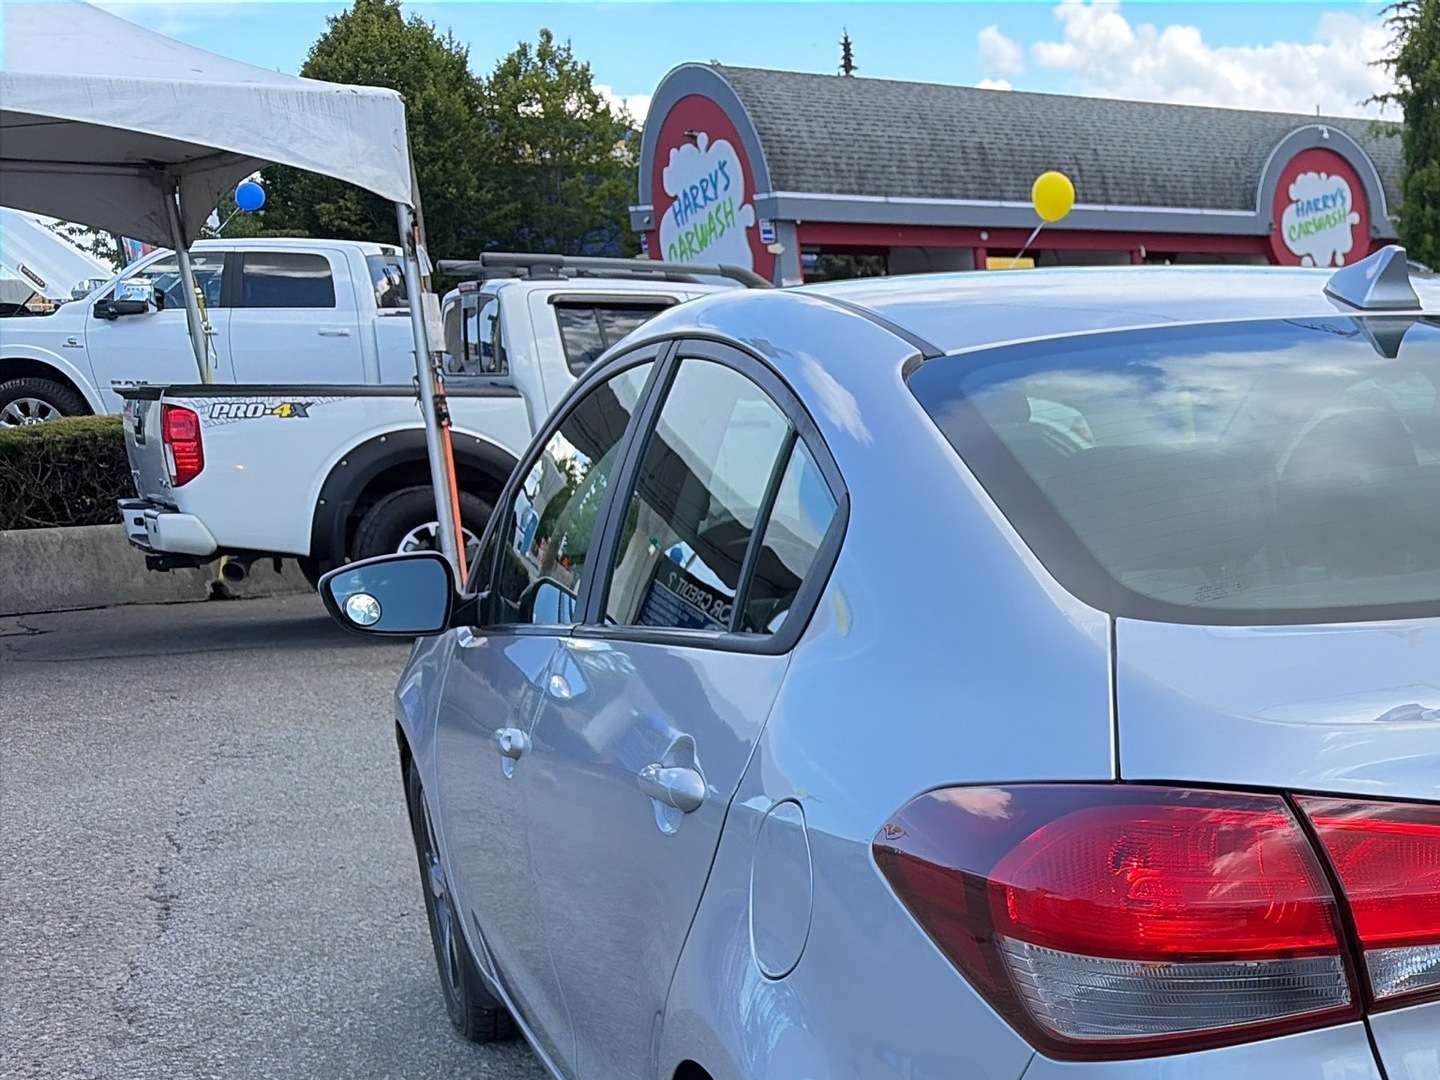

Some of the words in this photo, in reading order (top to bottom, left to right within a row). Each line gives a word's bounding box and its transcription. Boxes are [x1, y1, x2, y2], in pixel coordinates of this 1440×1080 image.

[672, 160, 731, 228] HARRY'S
[668, 196, 736, 262] CARWASH
[1288, 207, 1346, 241] CARWASH
[209, 402, 315, 419] PRO-4X
